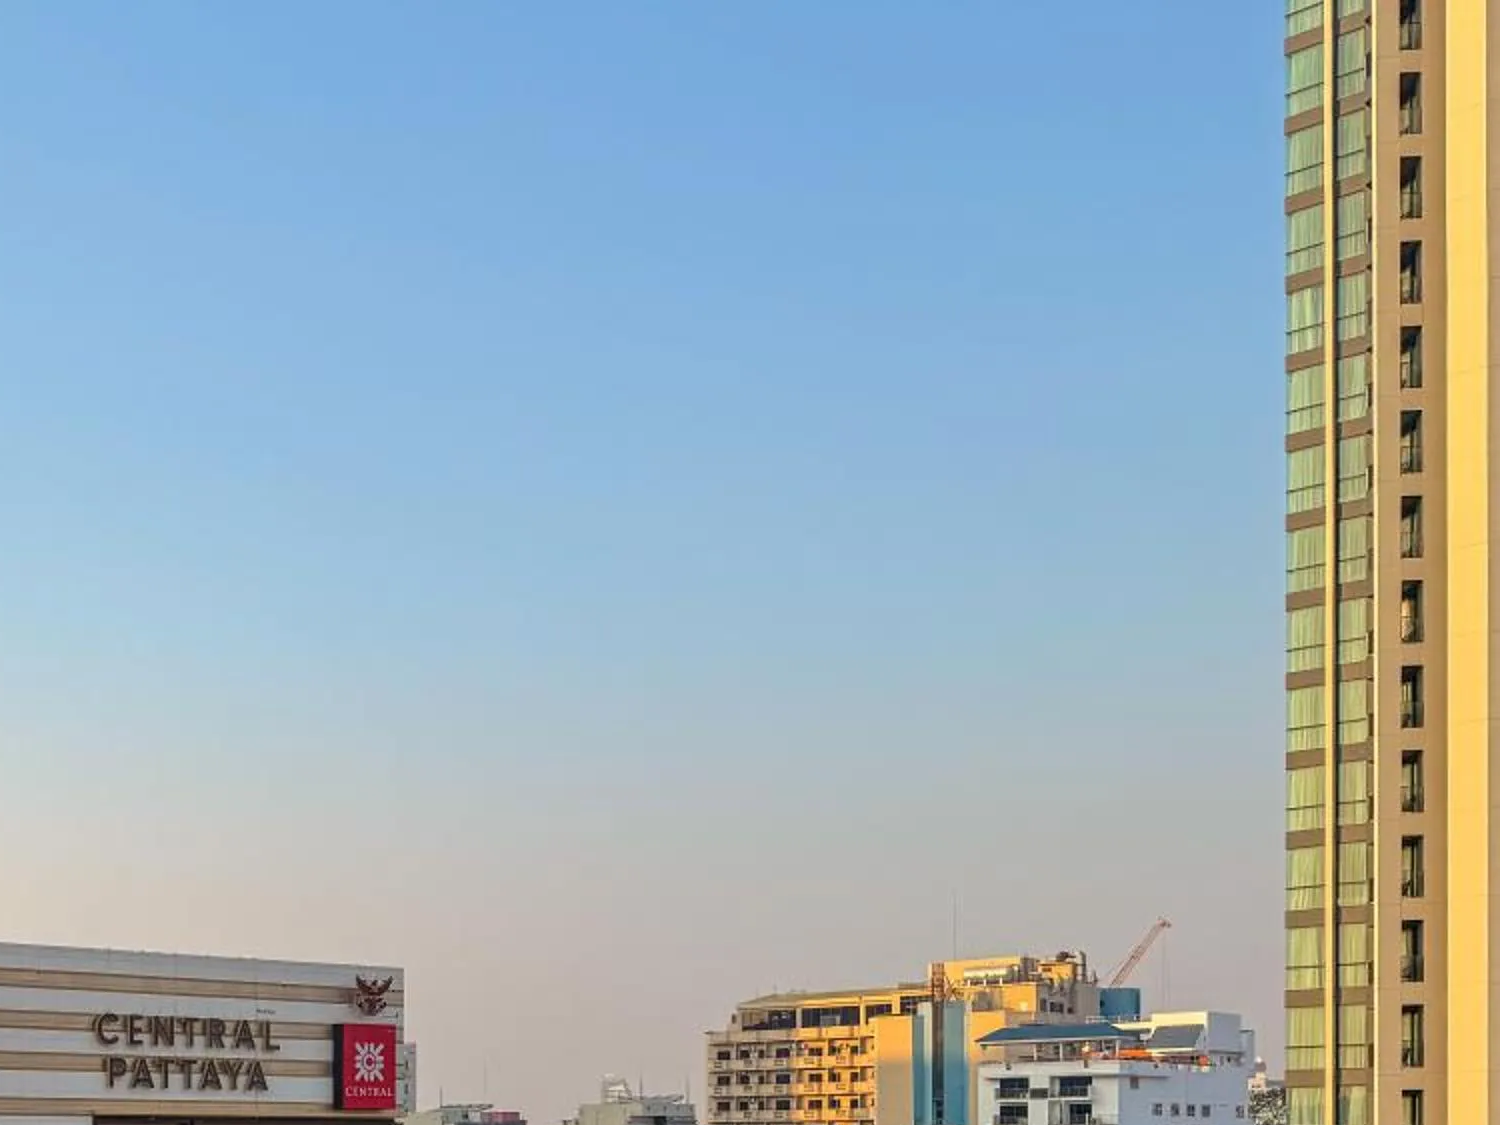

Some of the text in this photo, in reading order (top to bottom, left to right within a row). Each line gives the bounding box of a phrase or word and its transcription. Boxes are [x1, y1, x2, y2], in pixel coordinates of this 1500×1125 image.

[93, 1012, 280, 1051] CENTRAL
[101, 1056, 269, 1091] PATTAYA
[345, 1086, 394, 1097] CENTRAL
